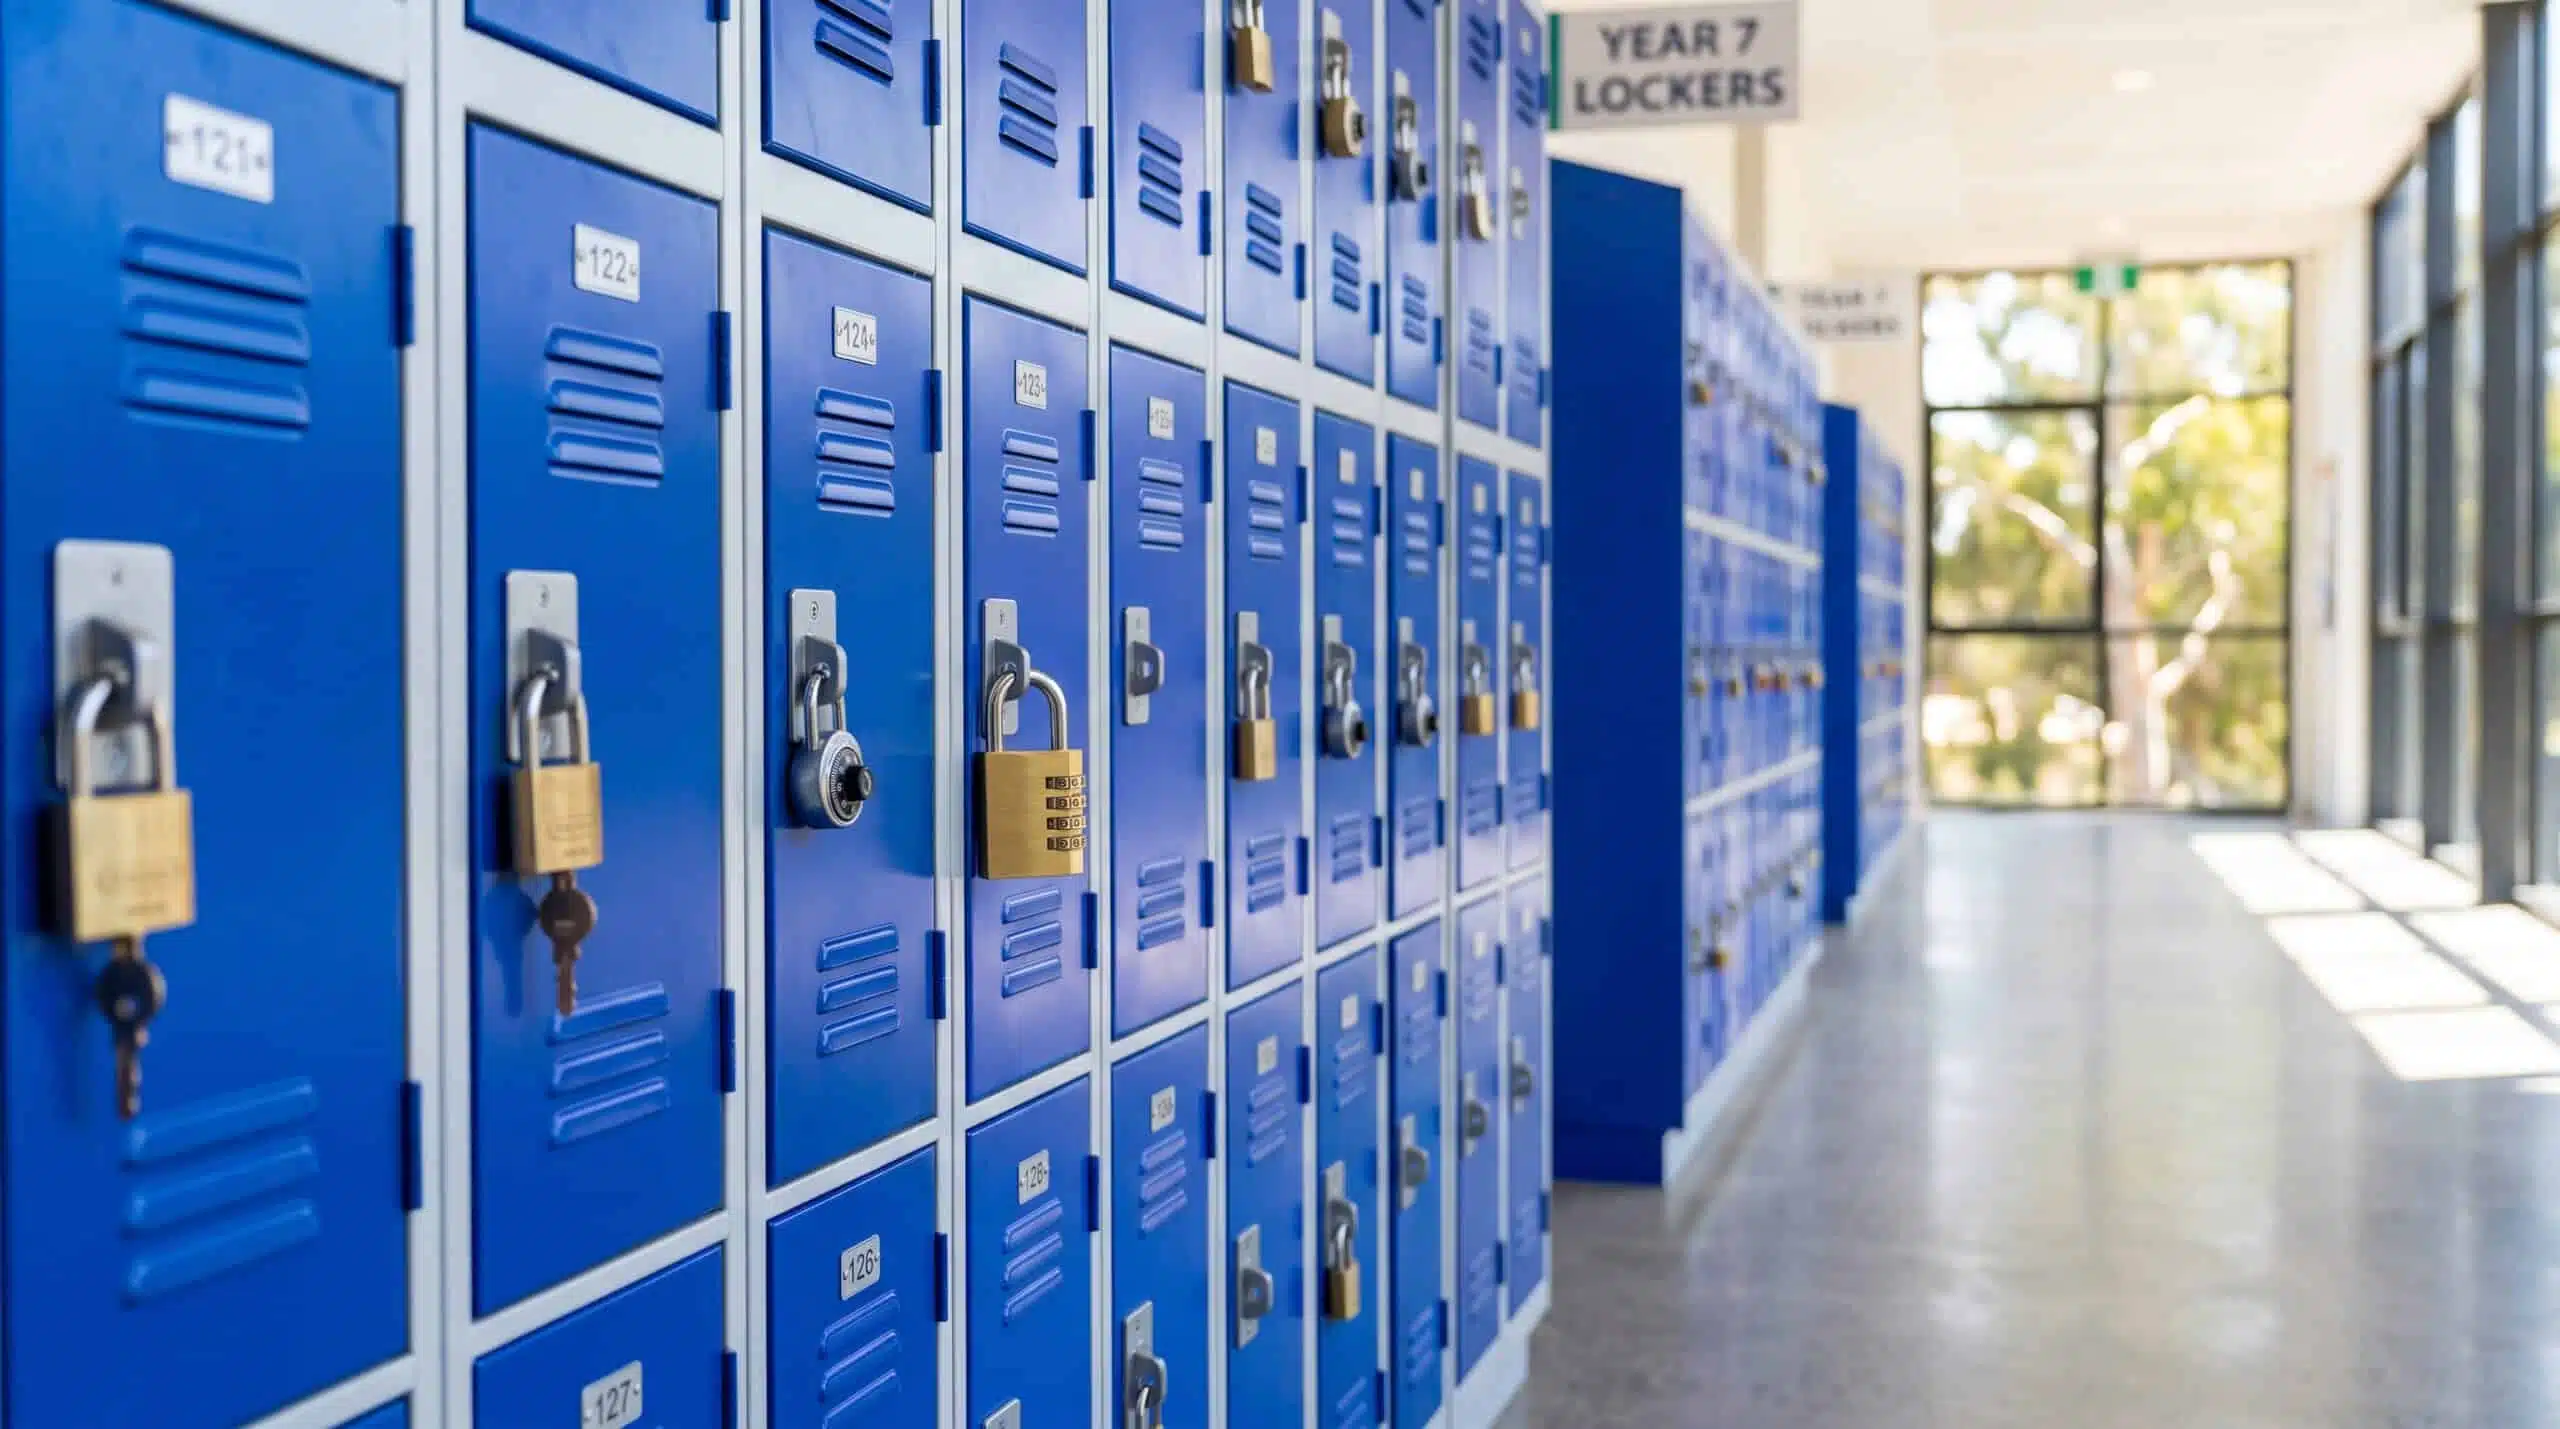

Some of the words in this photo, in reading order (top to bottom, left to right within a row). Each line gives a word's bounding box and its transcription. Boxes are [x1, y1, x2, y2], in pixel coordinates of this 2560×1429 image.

[1598, 19, 1719, 62] YEAR
[1735, 16, 1761, 55] 7
[1573, 66, 1787, 114] LOCKERS
[191, 121, 249, 179] 121
[588, 243, 628, 284] 122
[843, 319, 869, 353] 124
[849, 1247, 874, 1285] 126
[596, 1378, 632, 1426] 127
